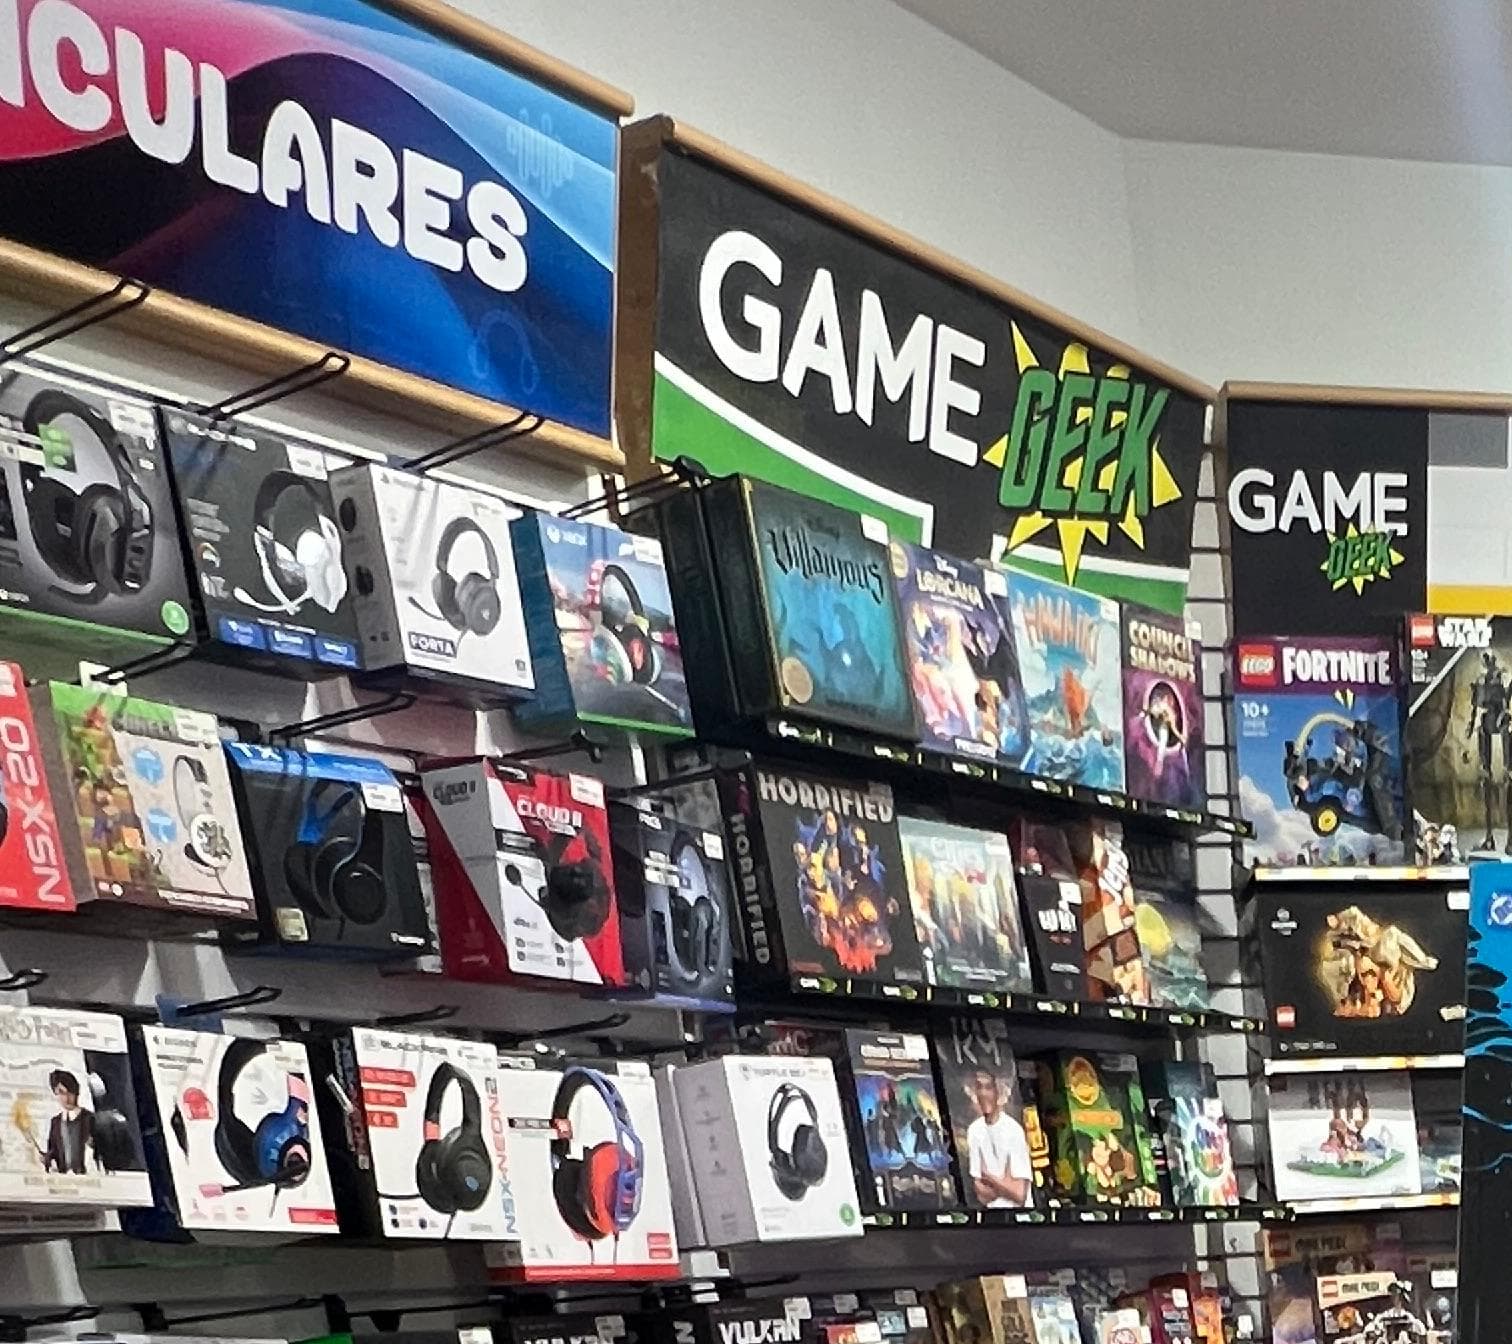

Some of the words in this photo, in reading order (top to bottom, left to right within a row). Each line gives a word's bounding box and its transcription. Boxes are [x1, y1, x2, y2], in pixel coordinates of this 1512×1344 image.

[700, 231, 986, 467] GAME
[1000, 365, 1172, 518] GEEK
[1229, 469, 1408, 536] GAME
[1282, 647, 1393, 686] FORTNITE
[758, 772, 894, 824] HORRIFIED
